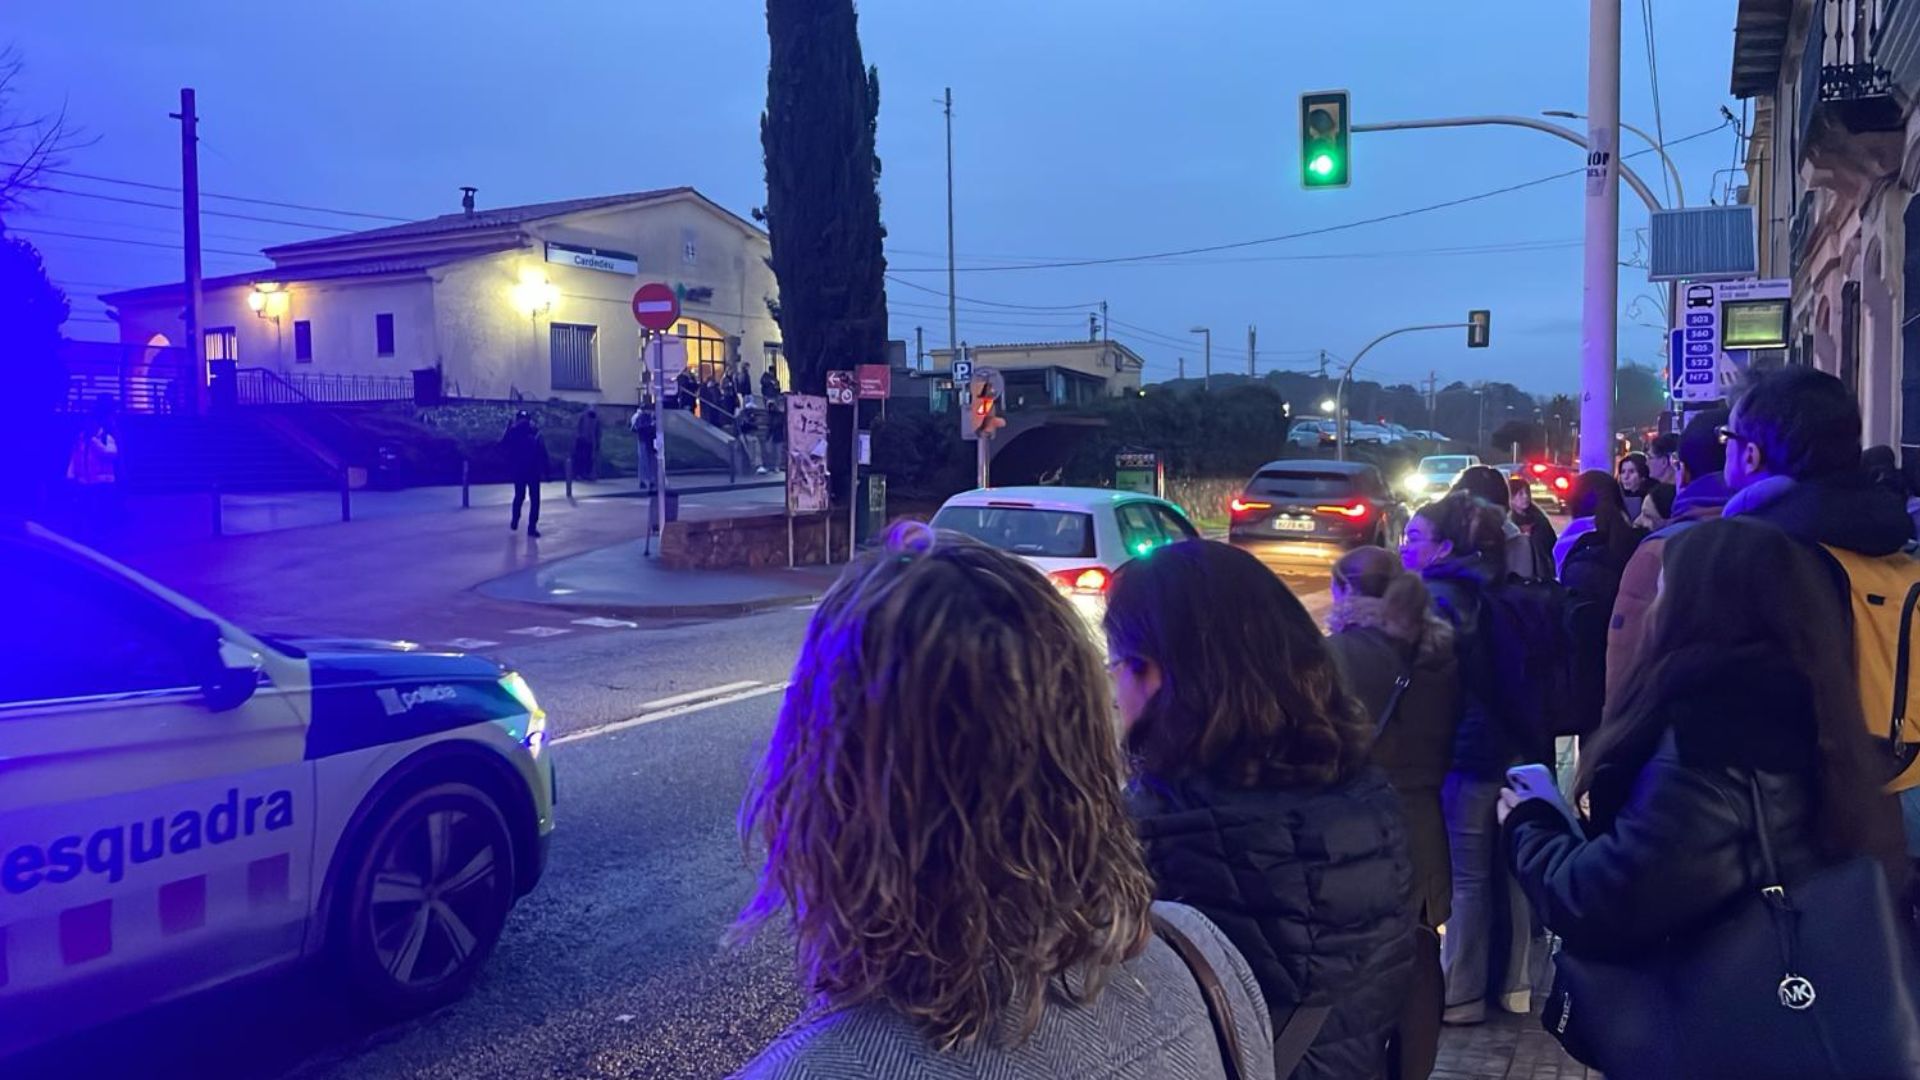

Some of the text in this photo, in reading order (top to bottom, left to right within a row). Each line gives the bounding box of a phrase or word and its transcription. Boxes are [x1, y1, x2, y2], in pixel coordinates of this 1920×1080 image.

[574, 255, 615, 270] Cardedeu
[957, 364, 969, 380] P
[1, 788, 293, 894] esquadra
[1781, 984, 1811, 1005] MK
